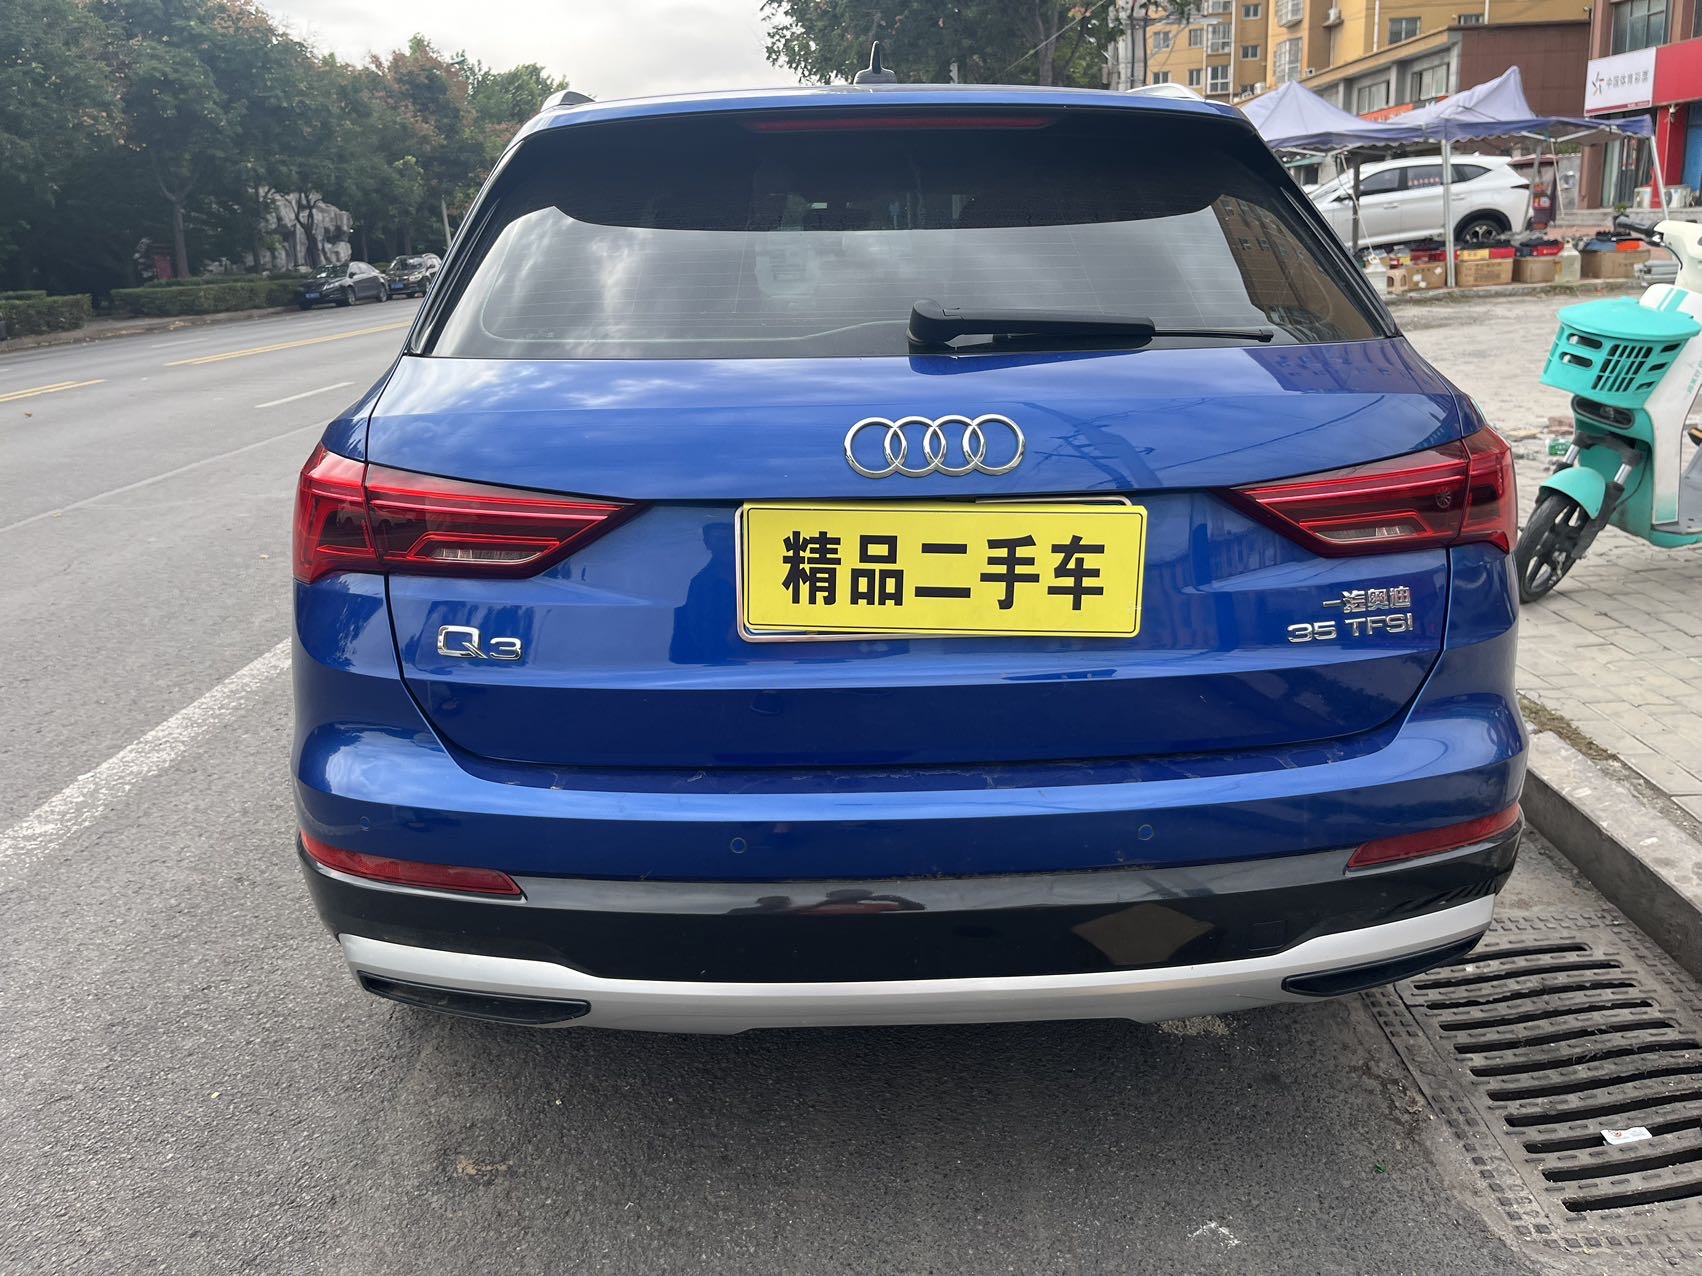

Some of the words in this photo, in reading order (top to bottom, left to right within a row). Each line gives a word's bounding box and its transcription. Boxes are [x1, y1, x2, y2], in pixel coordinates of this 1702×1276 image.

[781, 531, 1106, 611] 精品二手车
[437, 625, 522, 660] Q3
[1287, 621, 1338, 643] 35
[1345, 613, 1414, 637] TFSI
